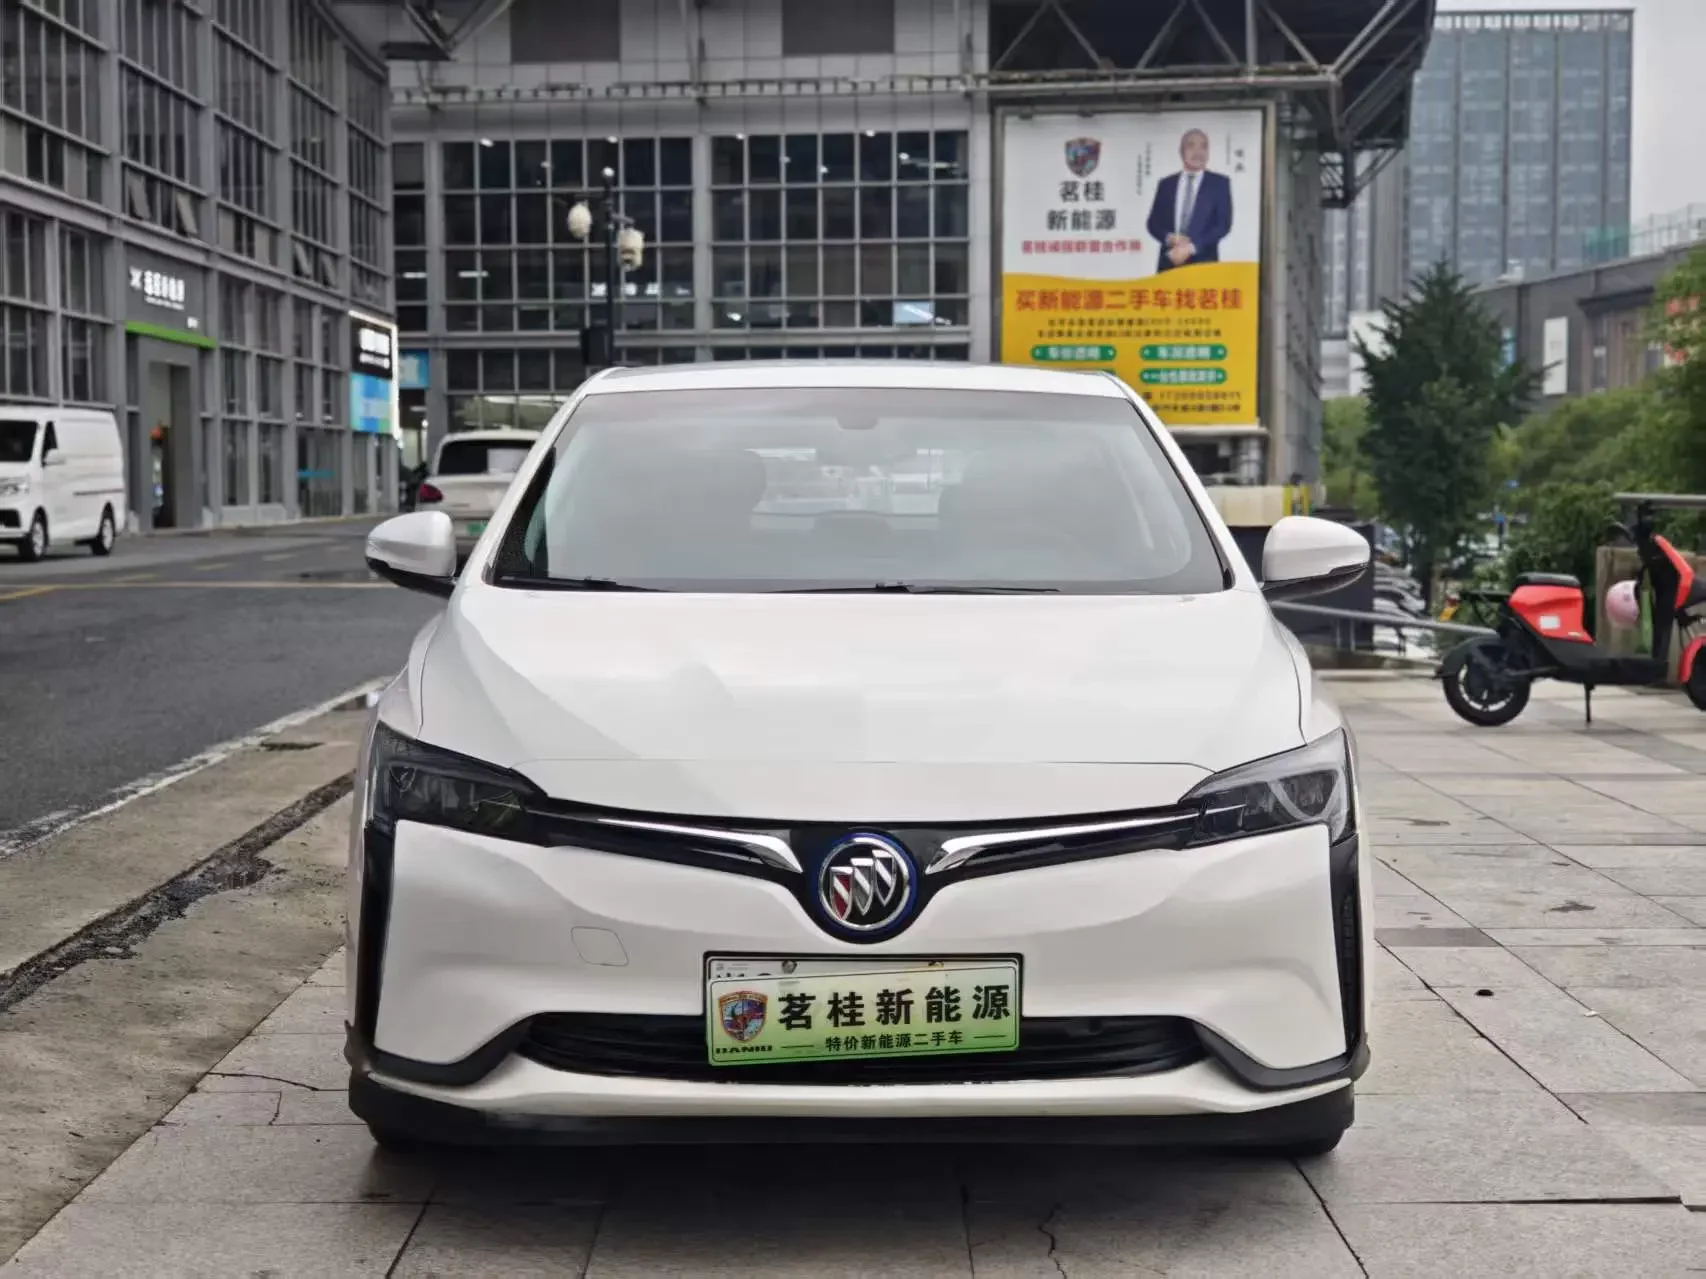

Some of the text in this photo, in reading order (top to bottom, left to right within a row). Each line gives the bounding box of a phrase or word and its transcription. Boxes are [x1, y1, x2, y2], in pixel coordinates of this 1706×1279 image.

[1059, 180, 1105, 202] 茗桂
[1046, 208, 1116, 231] 新能源
[1016, 288, 1243, 312] 买新能源二手车找茗桂
[778, 984, 1011, 1031] 茗桂新能源
[825, 1030, 964, 1053] 特价新能源二手车
